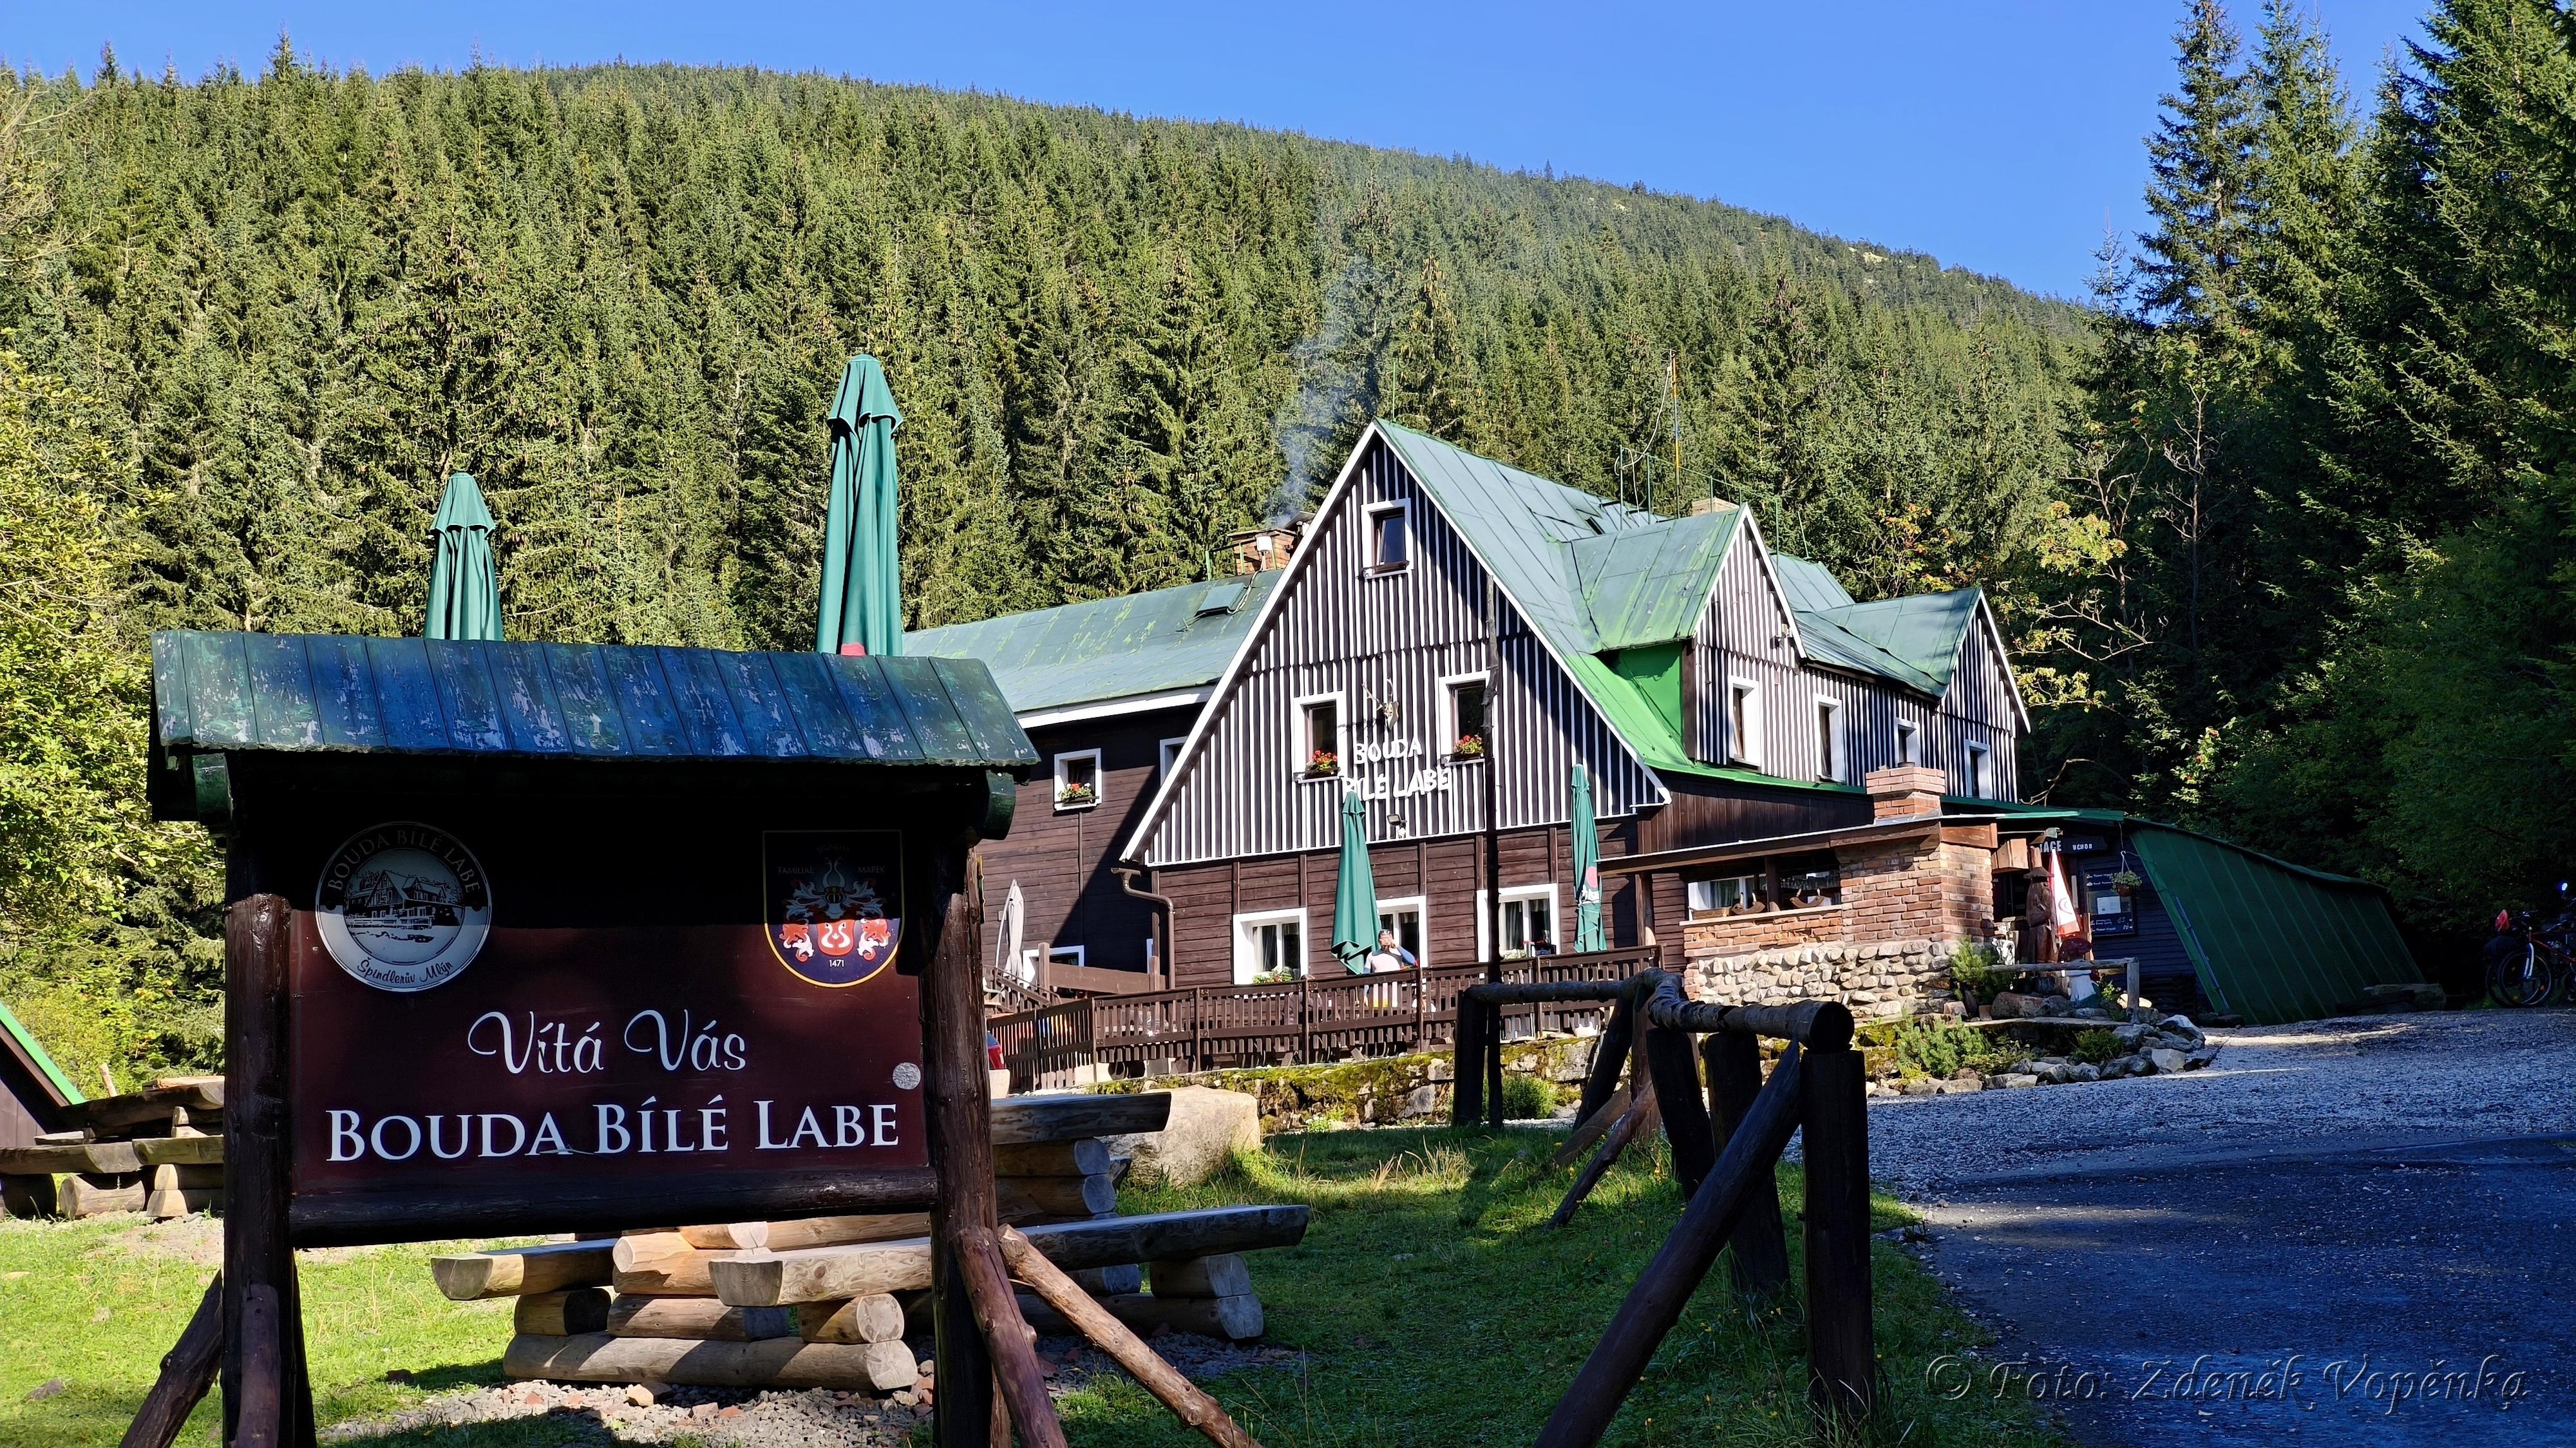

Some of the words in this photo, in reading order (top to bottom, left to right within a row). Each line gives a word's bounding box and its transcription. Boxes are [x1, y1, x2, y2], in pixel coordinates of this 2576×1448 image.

[1353, 738, 1422, 764] BOUDA
[1392, 767, 1449, 799] LABE
[327, 835, 390, 891] BOUDA
[397, 829, 442, 852] BÍLÉ
[444, 848, 481, 894] LABE
[357, 957, 416, 984] Špindlerův
[419, 962, 453, 982] Mlýn
[829, 959, 845, 968] 1471
[468, 1011, 604, 1074] Vítá
[624, 1009, 746, 1071] Vás
[325, 1109, 573, 1161] BOUDA
[593, 1094, 728, 1154] BÍLÉ
[753, 1100, 899, 1150] LABE
